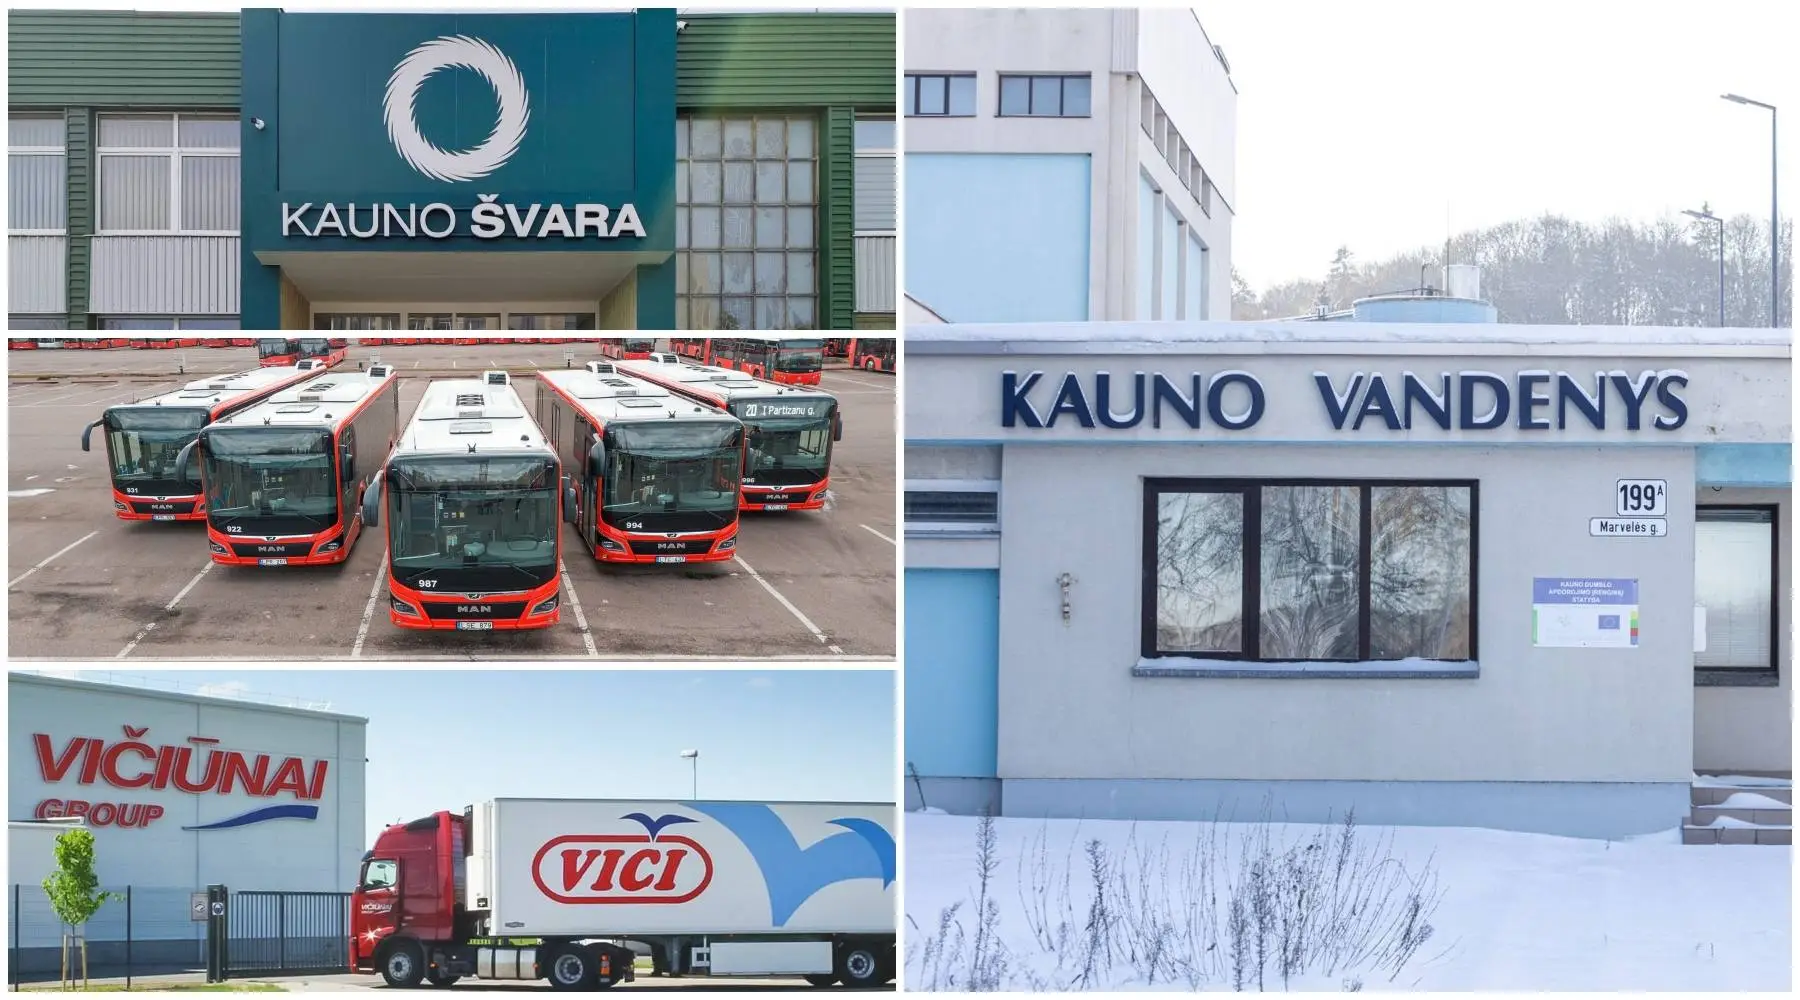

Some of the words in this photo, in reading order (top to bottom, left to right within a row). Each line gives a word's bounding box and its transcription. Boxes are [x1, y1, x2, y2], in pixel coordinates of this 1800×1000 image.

[282, 202, 456, 238] KAUNO
[470, 193, 647, 238] ŠVARA
[746, 404, 757, 416] 20
[1001, 370, 1266, 430] KAUNO
[1313, 370, 1689, 430] VANDENYS
[1600, 520, 1646, 533] Marvelės
[1650, 524, 1659, 536] g.
[418, 580, 437, 588] 987
[457, 605, 492, 613] MAN
[33, 725, 328, 800] VIČIŪNAI
[35, 798, 165, 829] GROUP
[561, 848, 688, 892] VICI
